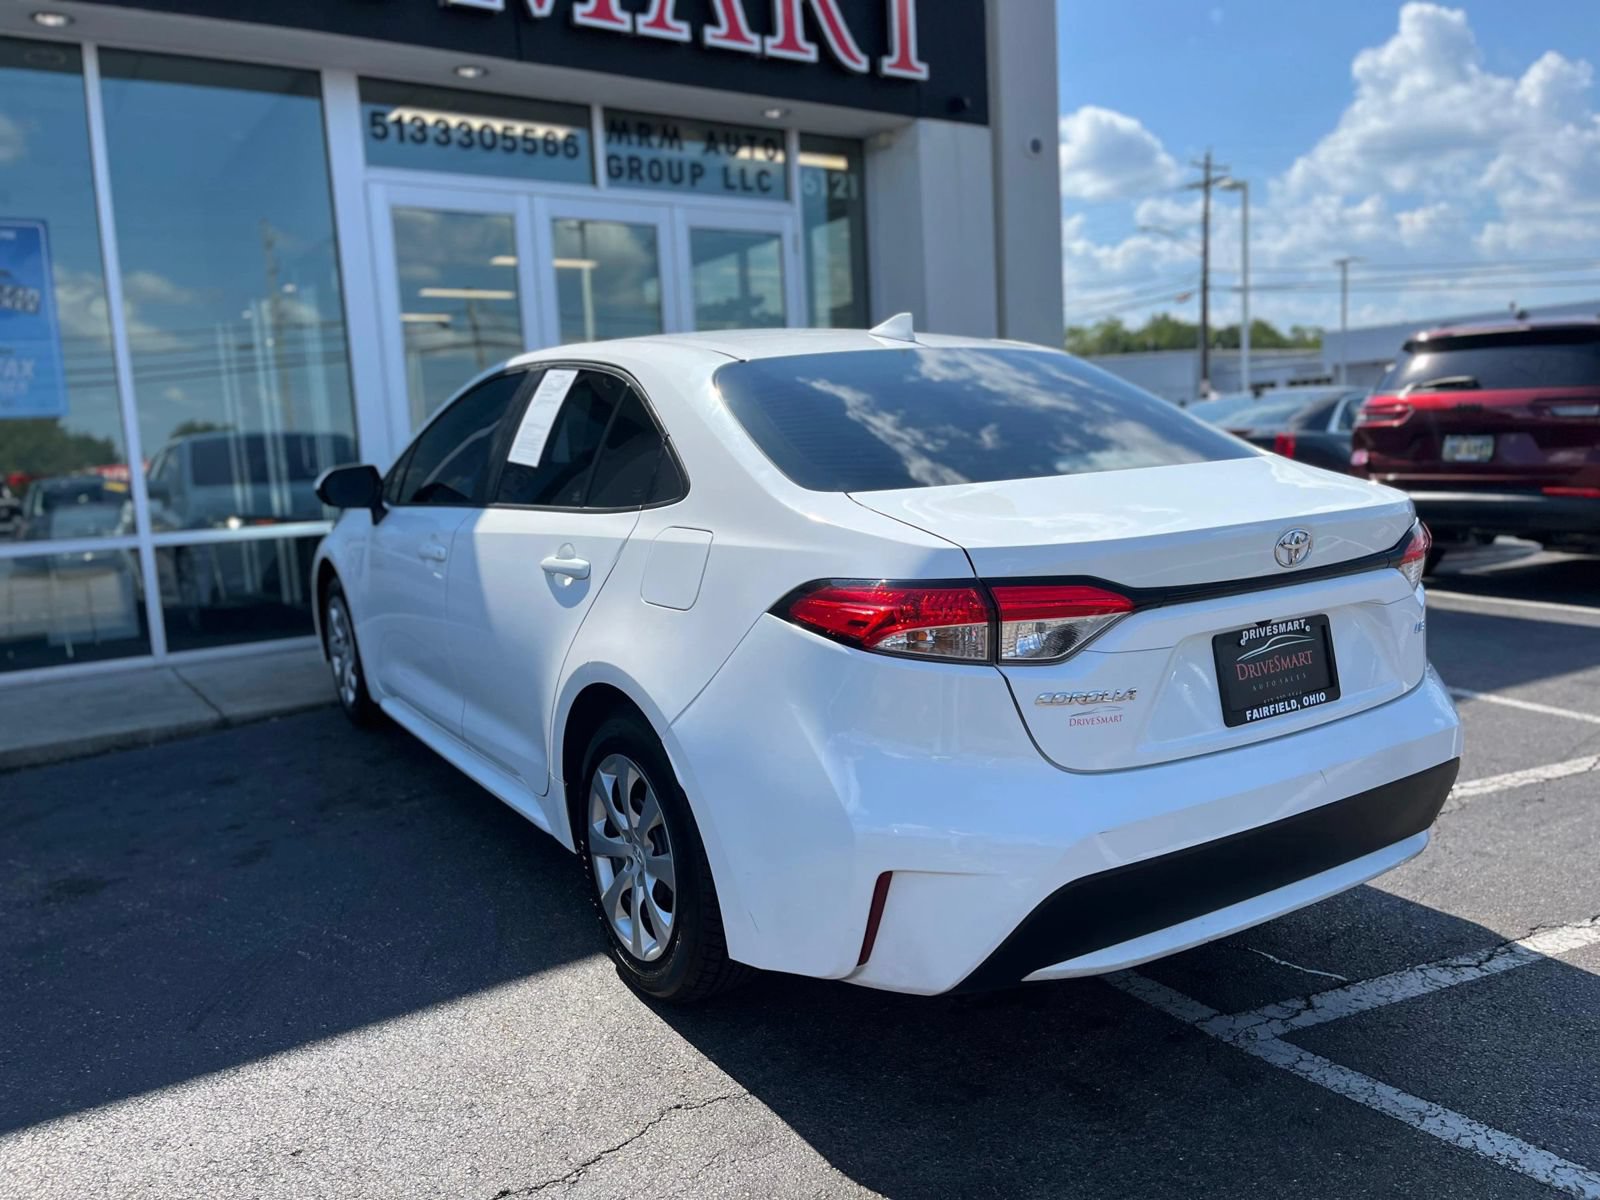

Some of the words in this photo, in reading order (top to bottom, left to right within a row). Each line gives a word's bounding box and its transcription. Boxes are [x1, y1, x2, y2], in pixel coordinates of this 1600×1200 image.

[371, 111, 580, 159] 5133305566
[606, 119, 684, 152] MRM
[702, 130, 782, 161] AUTO
[606, 154, 705, 187] GROUP
[722, 166, 773, 193] LLC
[1242, 618, 1307, 641] DRIVESMART
[1035, 686, 1138, 706] COROLLA
[1245, 699, 1302, 721] FAIRFIELD,
[1302, 691, 1327, 707] OHIO
